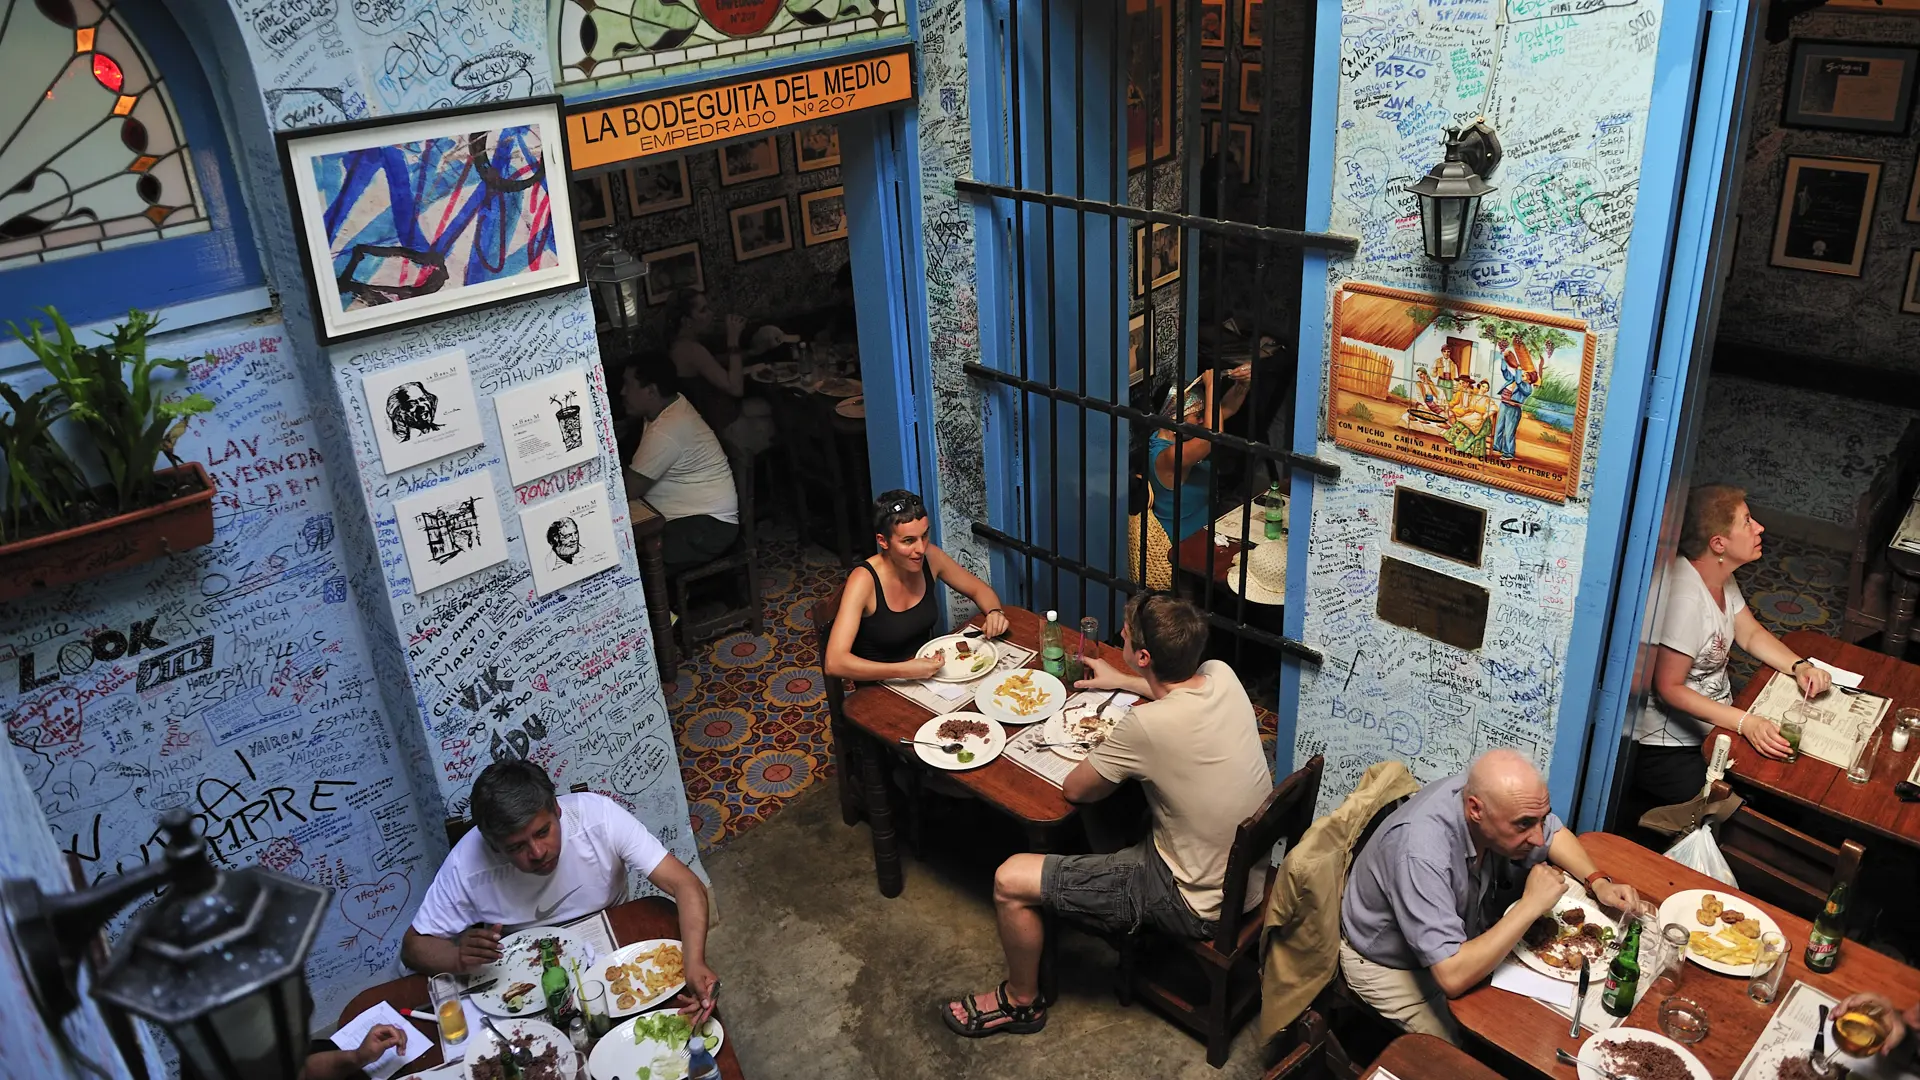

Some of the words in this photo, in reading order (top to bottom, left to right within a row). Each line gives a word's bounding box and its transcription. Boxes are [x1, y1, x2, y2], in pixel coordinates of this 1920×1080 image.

[1374, 61, 1427, 79] PABLO
[581, 112, 619, 144] LA
[622, 84, 769, 136] BODEGUITA
[774, 74, 819, 105] DEL
[823, 59, 891, 96] MEDIO
[639, 110, 776, 152] EMPEDRADO
[818, 93, 856, 113] 207
[1470, 262, 1510, 281] CULE
[1338, 420, 1353, 431] CON
[1356, 425, 1385, 438] MUCHO
[1431, 443, 1442, 453] AL
[1500, 518, 1542, 538] CIP
[1482, 724, 1523, 746] ISMAEL
[353, 882, 396, 904] THOMAS
